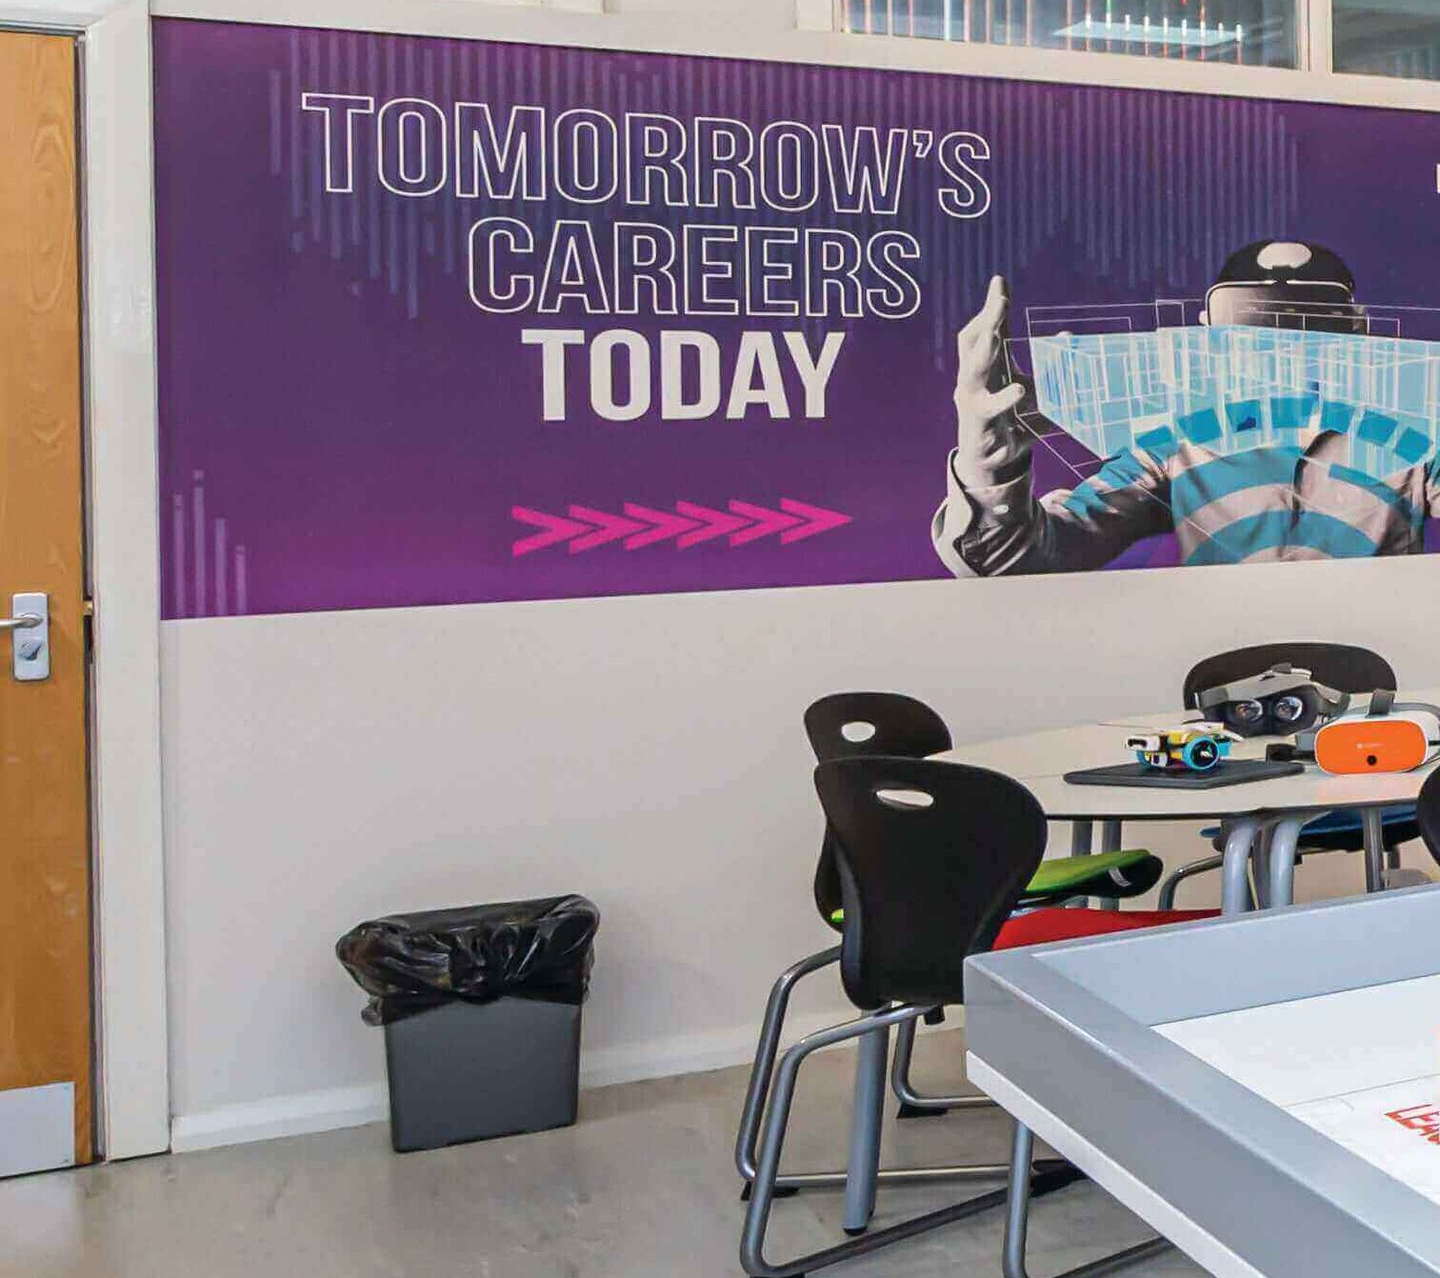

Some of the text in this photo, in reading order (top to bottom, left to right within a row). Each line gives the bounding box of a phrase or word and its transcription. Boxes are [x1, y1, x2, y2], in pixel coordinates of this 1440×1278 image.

[302, 93, 992, 219] TOMORROW'S
[467, 217, 922, 318] CAREERS
[521, 329, 845, 422] TODAY
